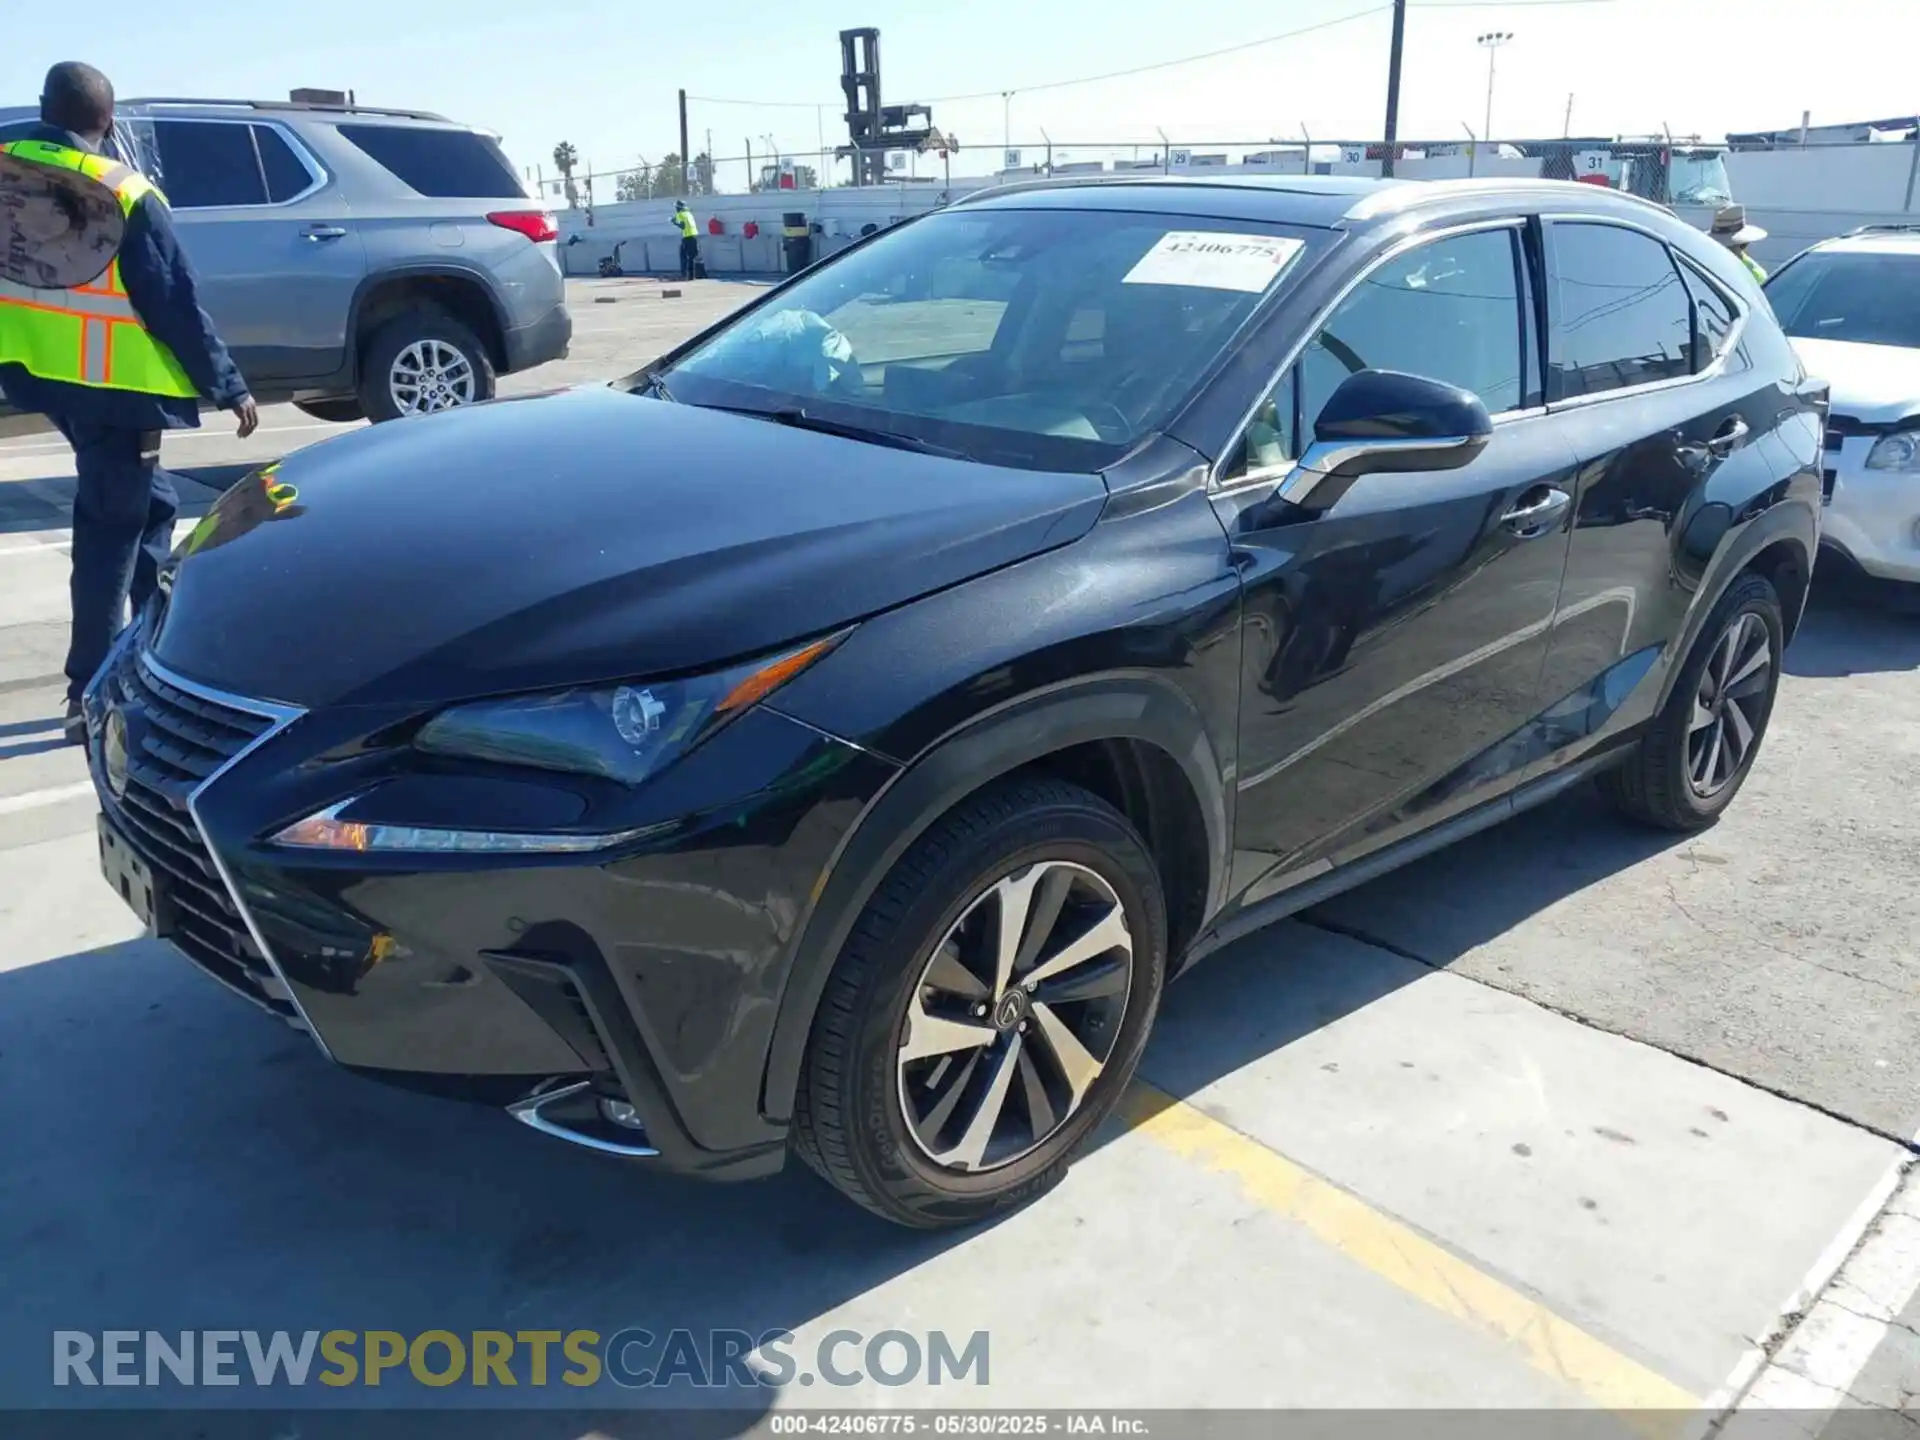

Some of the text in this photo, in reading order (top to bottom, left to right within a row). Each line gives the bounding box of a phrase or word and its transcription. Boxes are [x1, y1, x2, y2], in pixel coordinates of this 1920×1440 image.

[1174, 152, 1186, 164] 29
[1346, 151, 1360, 163] 30
[1588, 156, 1602, 169] 31
[1165, 242, 1276, 257] 42406775
